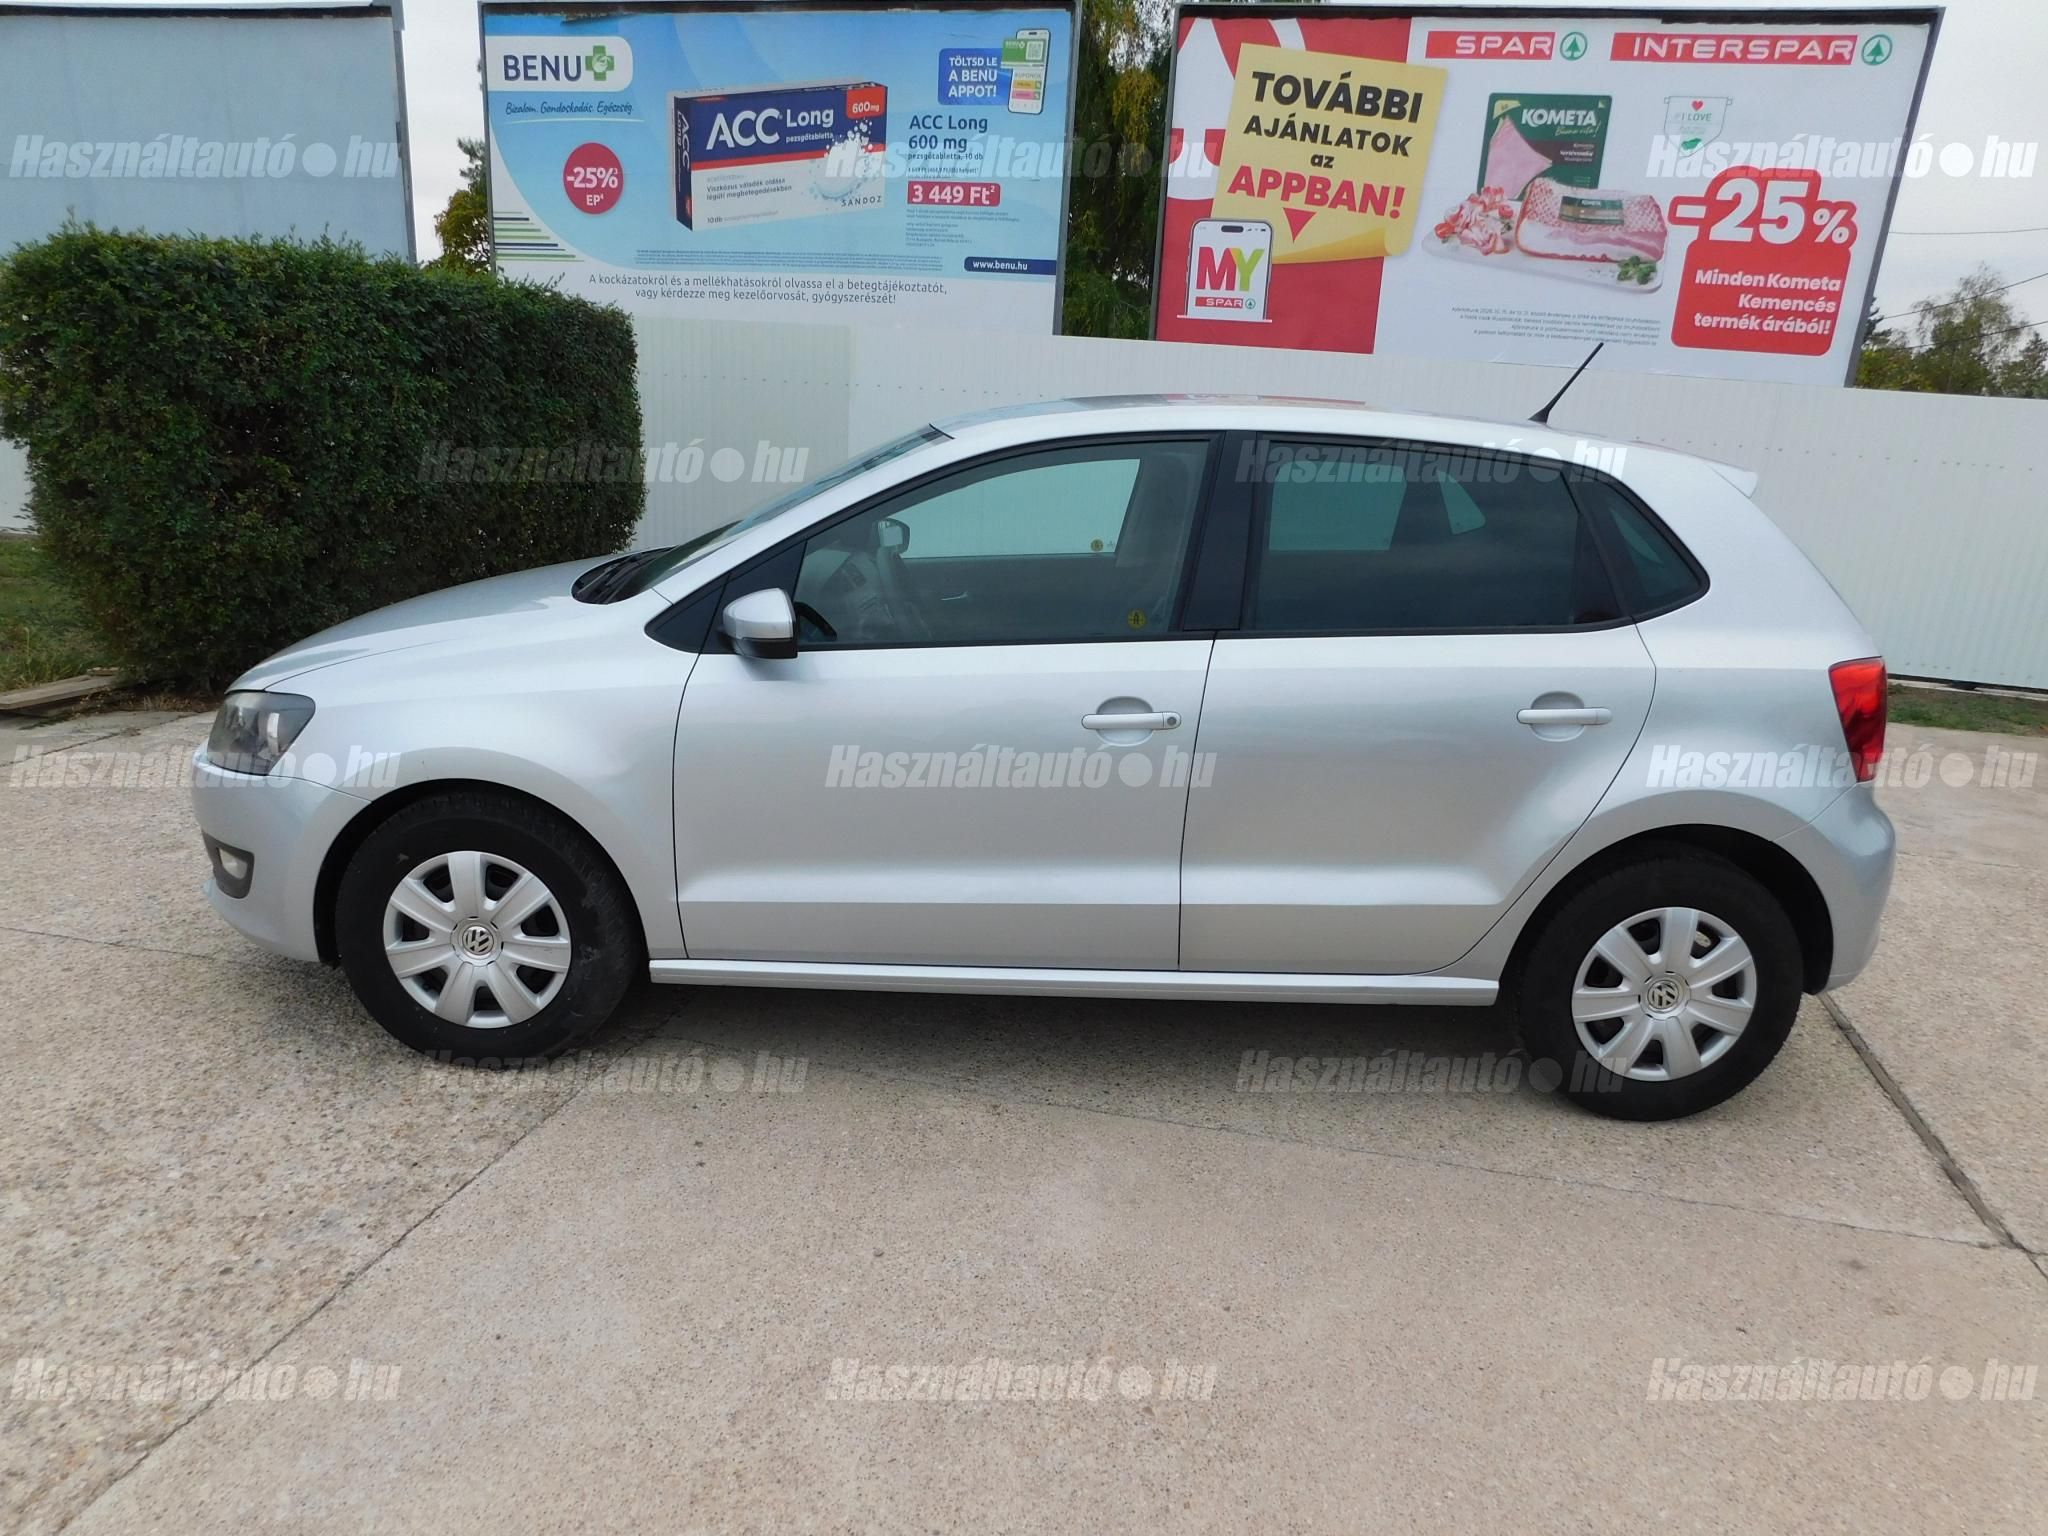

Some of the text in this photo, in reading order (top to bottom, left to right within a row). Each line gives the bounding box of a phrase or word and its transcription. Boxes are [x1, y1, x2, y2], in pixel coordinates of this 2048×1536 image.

[1456, 35, 1551, 55] SPAR
[1633, 36, 1853, 60] INTERSPAR
[503, 55, 582, 81] BENU
[949, 56, 998, 66] TÖLTSD LE
[948, 70, 997, 82] A BENU
[948, 85, 997, 98] APPOT!
[1252, 71, 1423, 123] TOVÁBBI
[909, 115, 988, 132] ACC Long
[1522, 109, 1597, 127] KOMETA
[1687, 113, 1712, 121] LOVE
[706, 108, 834, 150] ACC Long
[1243, 112, 1412, 157] AJÁNLATOK
[909, 135, 967, 153] 600 mg
[1310, 154, 1334, 168] az
[841, 195, 882, 207] SANDOZ
[912, 185, 923, 202] 3
[928, 185, 964, 203] 449
[1227, 165, 1405, 219] APPBAN!
[972, 260, 1028, 271] www.benu.hu
[1196, 246, 1265, 292] MY
[589, 274, 596, 284] A
[599, 274, 668, 286] kockázatokról
[670, 275, 682, 286] és
[693, 276, 782, 288] mellékhatásokról
[784, 278, 822, 289] olvassa
[825, 279, 835, 289] el
[847, 280, 947, 295] betegtájékoztatót,
[1695, 269, 1841, 292] Minden Kometa
[635, 287, 896, 304] vagy kérdezze meg kezelőorvosát, gyógyszerészét!
[1206, 298, 1242, 307] SPAR
[1739, 293, 1836, 313] Kemencés
[1694, 312, 1832, 335] termék árából!
